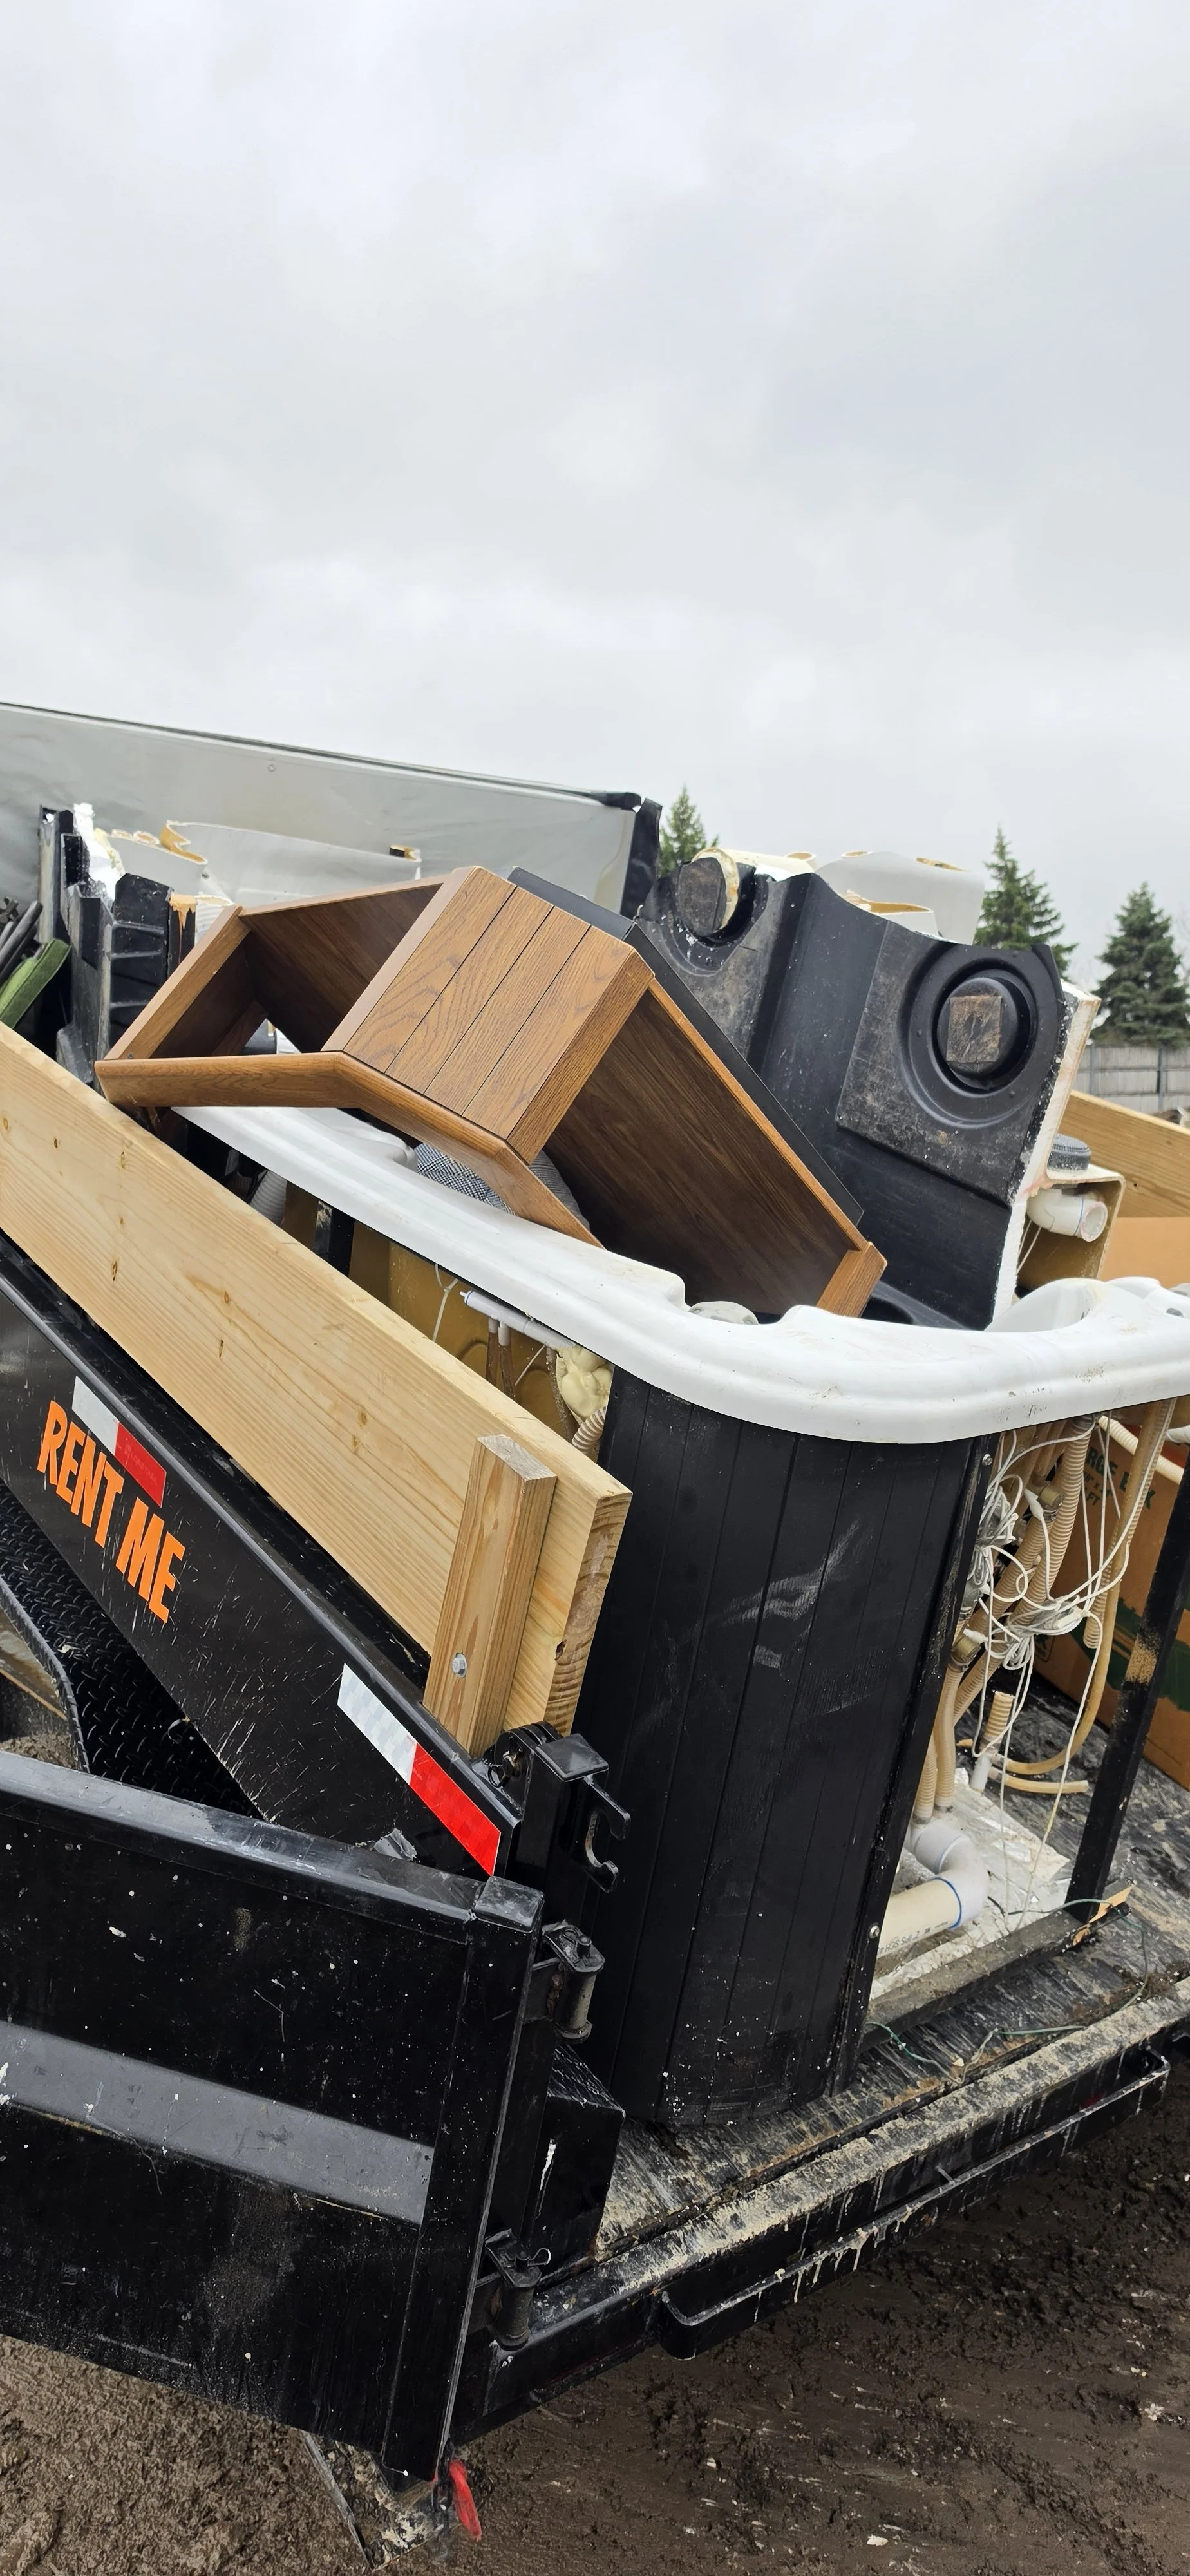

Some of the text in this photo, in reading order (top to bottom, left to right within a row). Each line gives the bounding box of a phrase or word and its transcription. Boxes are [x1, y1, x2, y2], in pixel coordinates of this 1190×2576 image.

[37, 1400, 185, 1624] RENT ME
[1086, 1447, 1118, 1477] RGE
